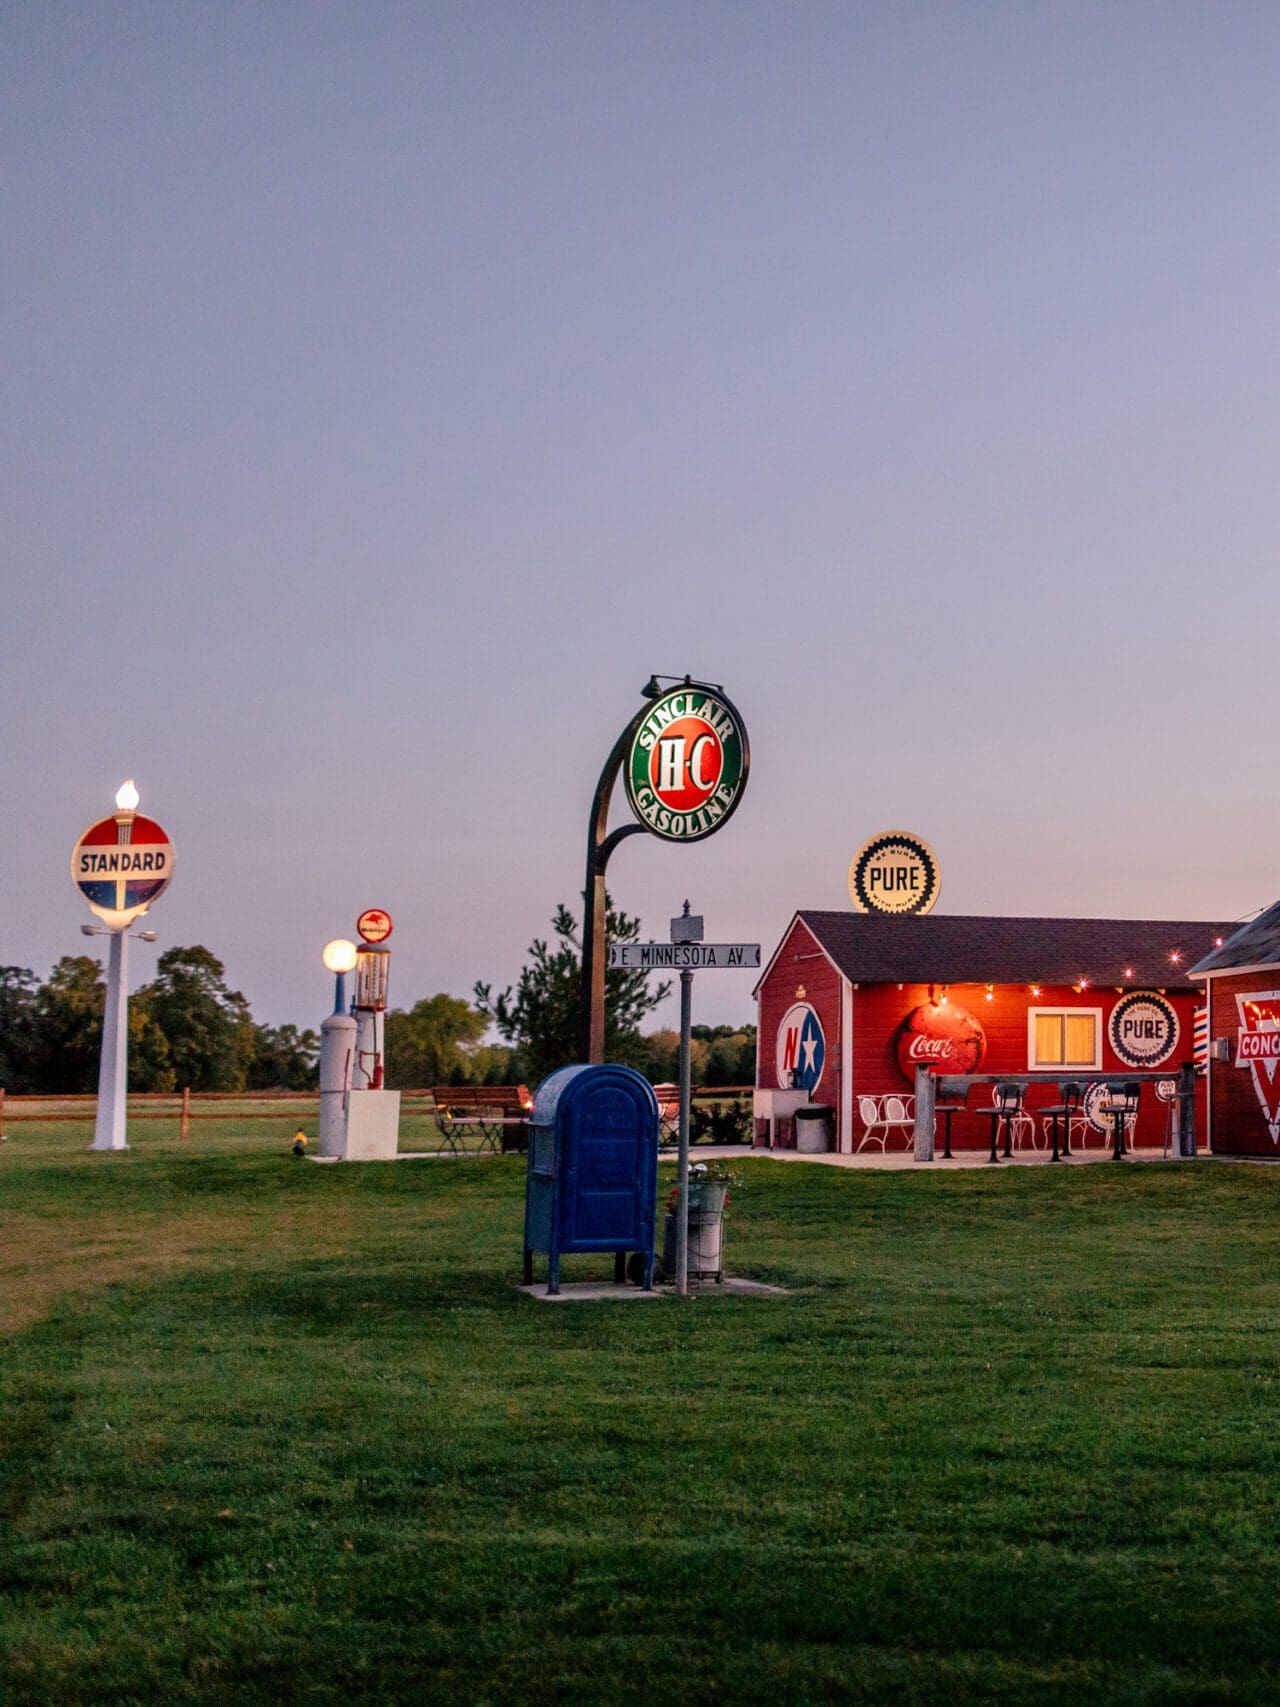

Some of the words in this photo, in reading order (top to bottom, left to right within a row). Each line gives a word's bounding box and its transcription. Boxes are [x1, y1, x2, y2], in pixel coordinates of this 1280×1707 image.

[639, 693, 735, 751] SINCLAIR
[637, 783, 735, 836] GASOLINE
[80, 851, 166, 873] STANDARD
[870, 866, 920, 891] PURE
[621, 947, 634, 965] E.
[641, 947, 717, 966] MINNESOTA
[727, 947, 748, 966] AV.
[1123, 1020, 1165, 1039] PURE
